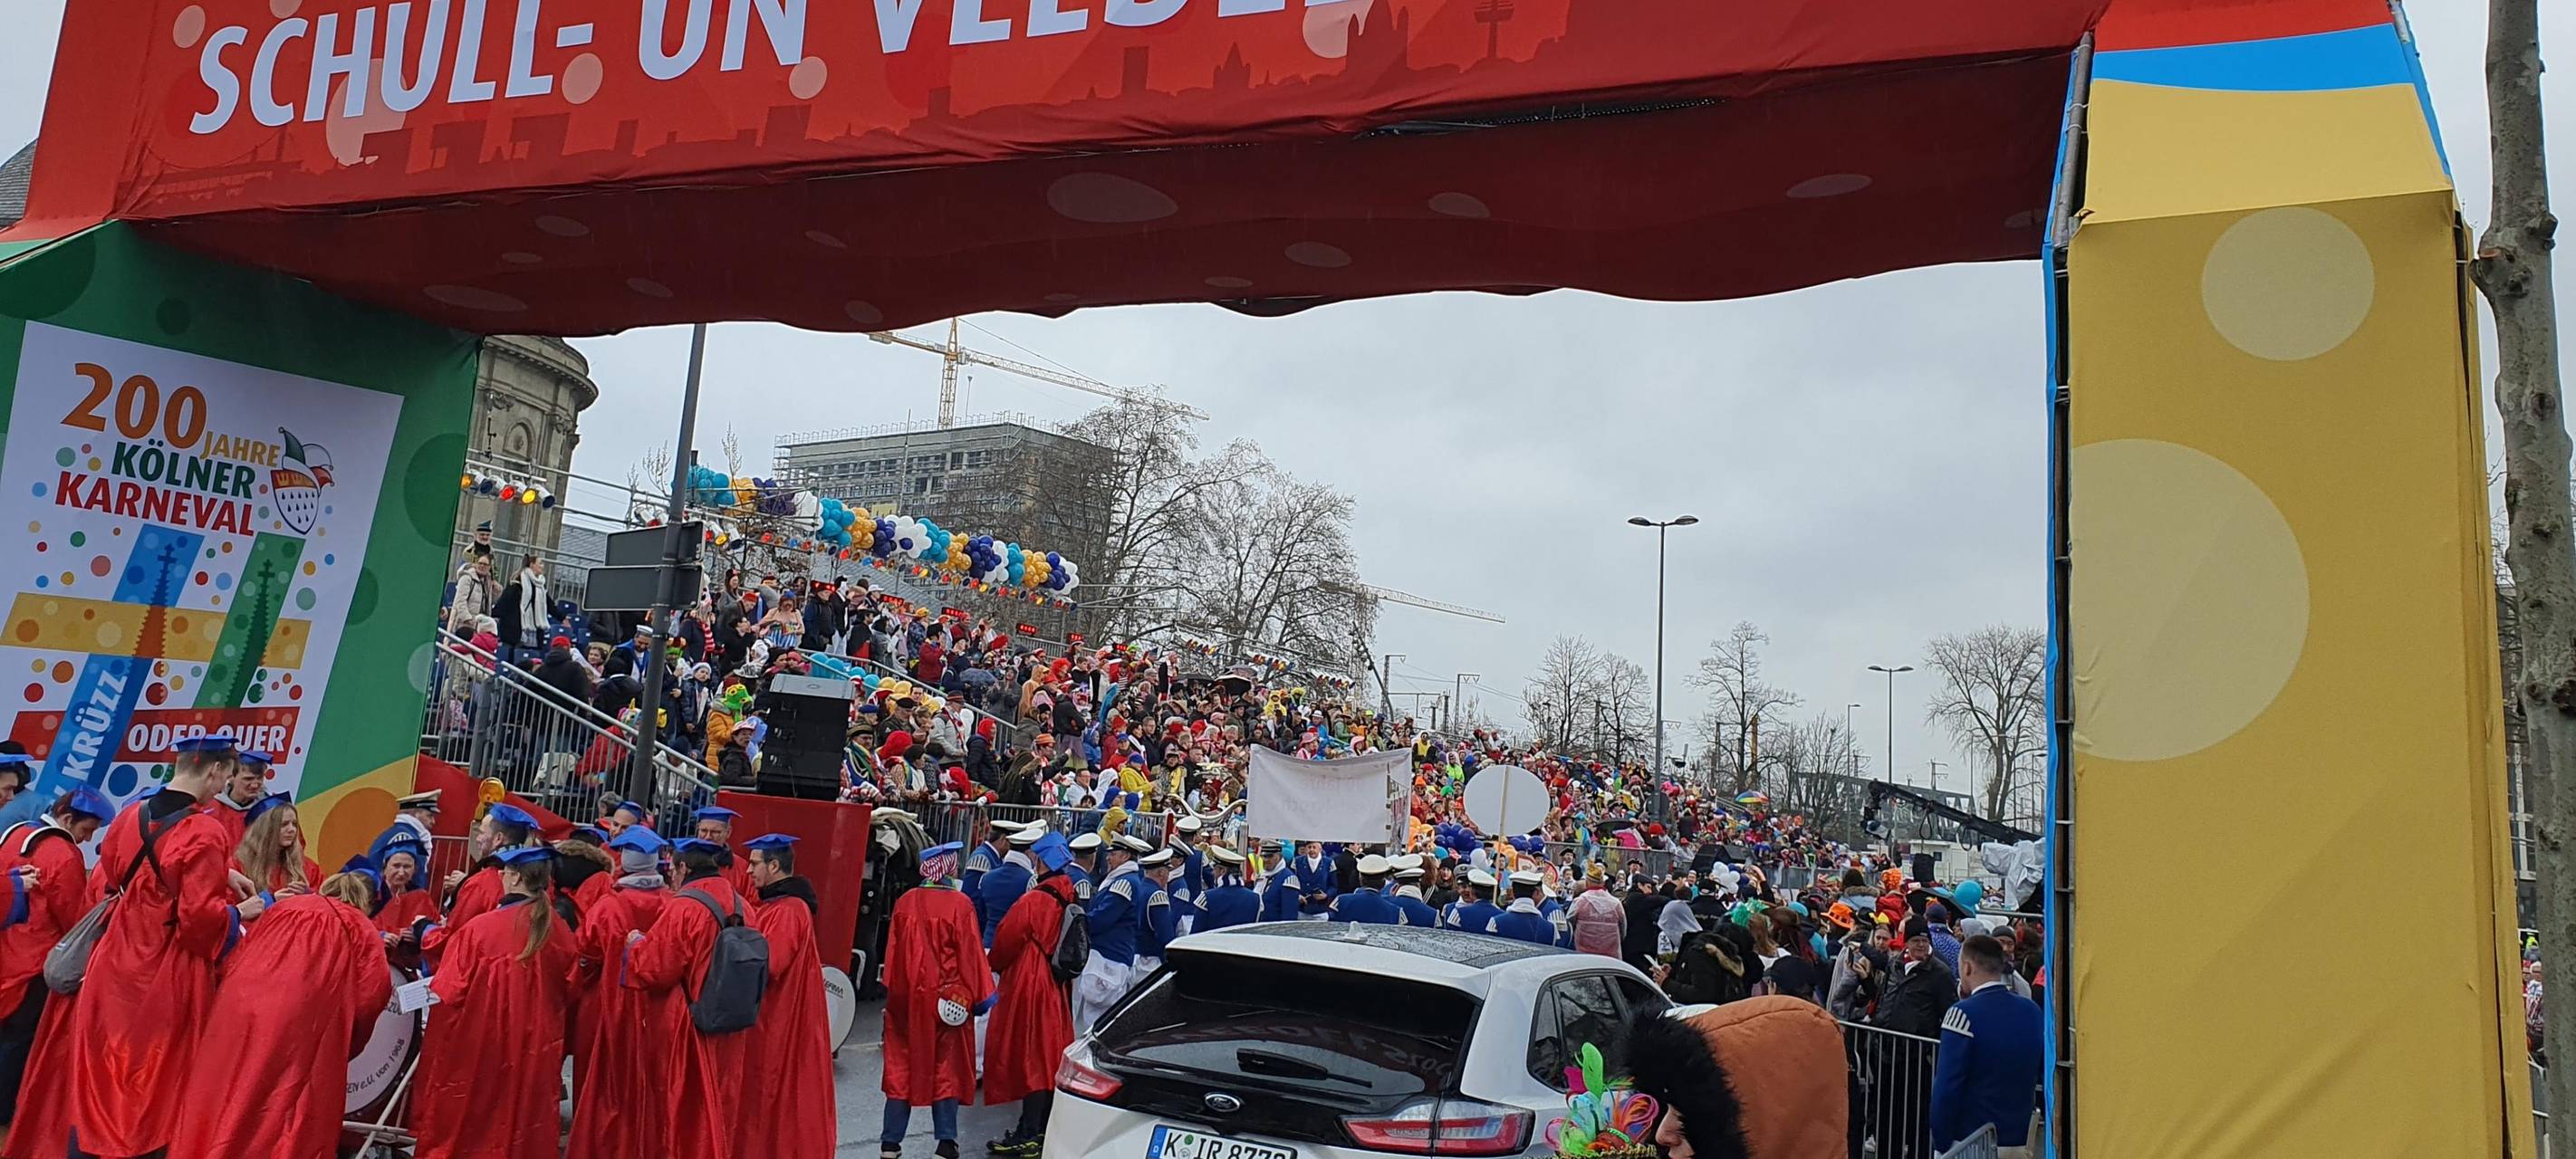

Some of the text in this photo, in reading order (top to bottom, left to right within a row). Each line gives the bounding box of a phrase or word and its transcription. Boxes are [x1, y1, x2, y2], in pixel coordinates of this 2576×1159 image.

[189, 0, 593, 134] SCHULL-
[639, 0, 806, 80] UN
[61, 362, 281, 467] 200 JAHRE
[111, 438, 255, 499] KÖLNER
[55, 470, 255, 536] KARNEVAL
[61, 669, 128, 781] KRÜZZ
[1152, 1145, 1159, 1154] D
[1164, 1132, 1183, 1158] K
[1194, 1137, 1223, 1159] IR
